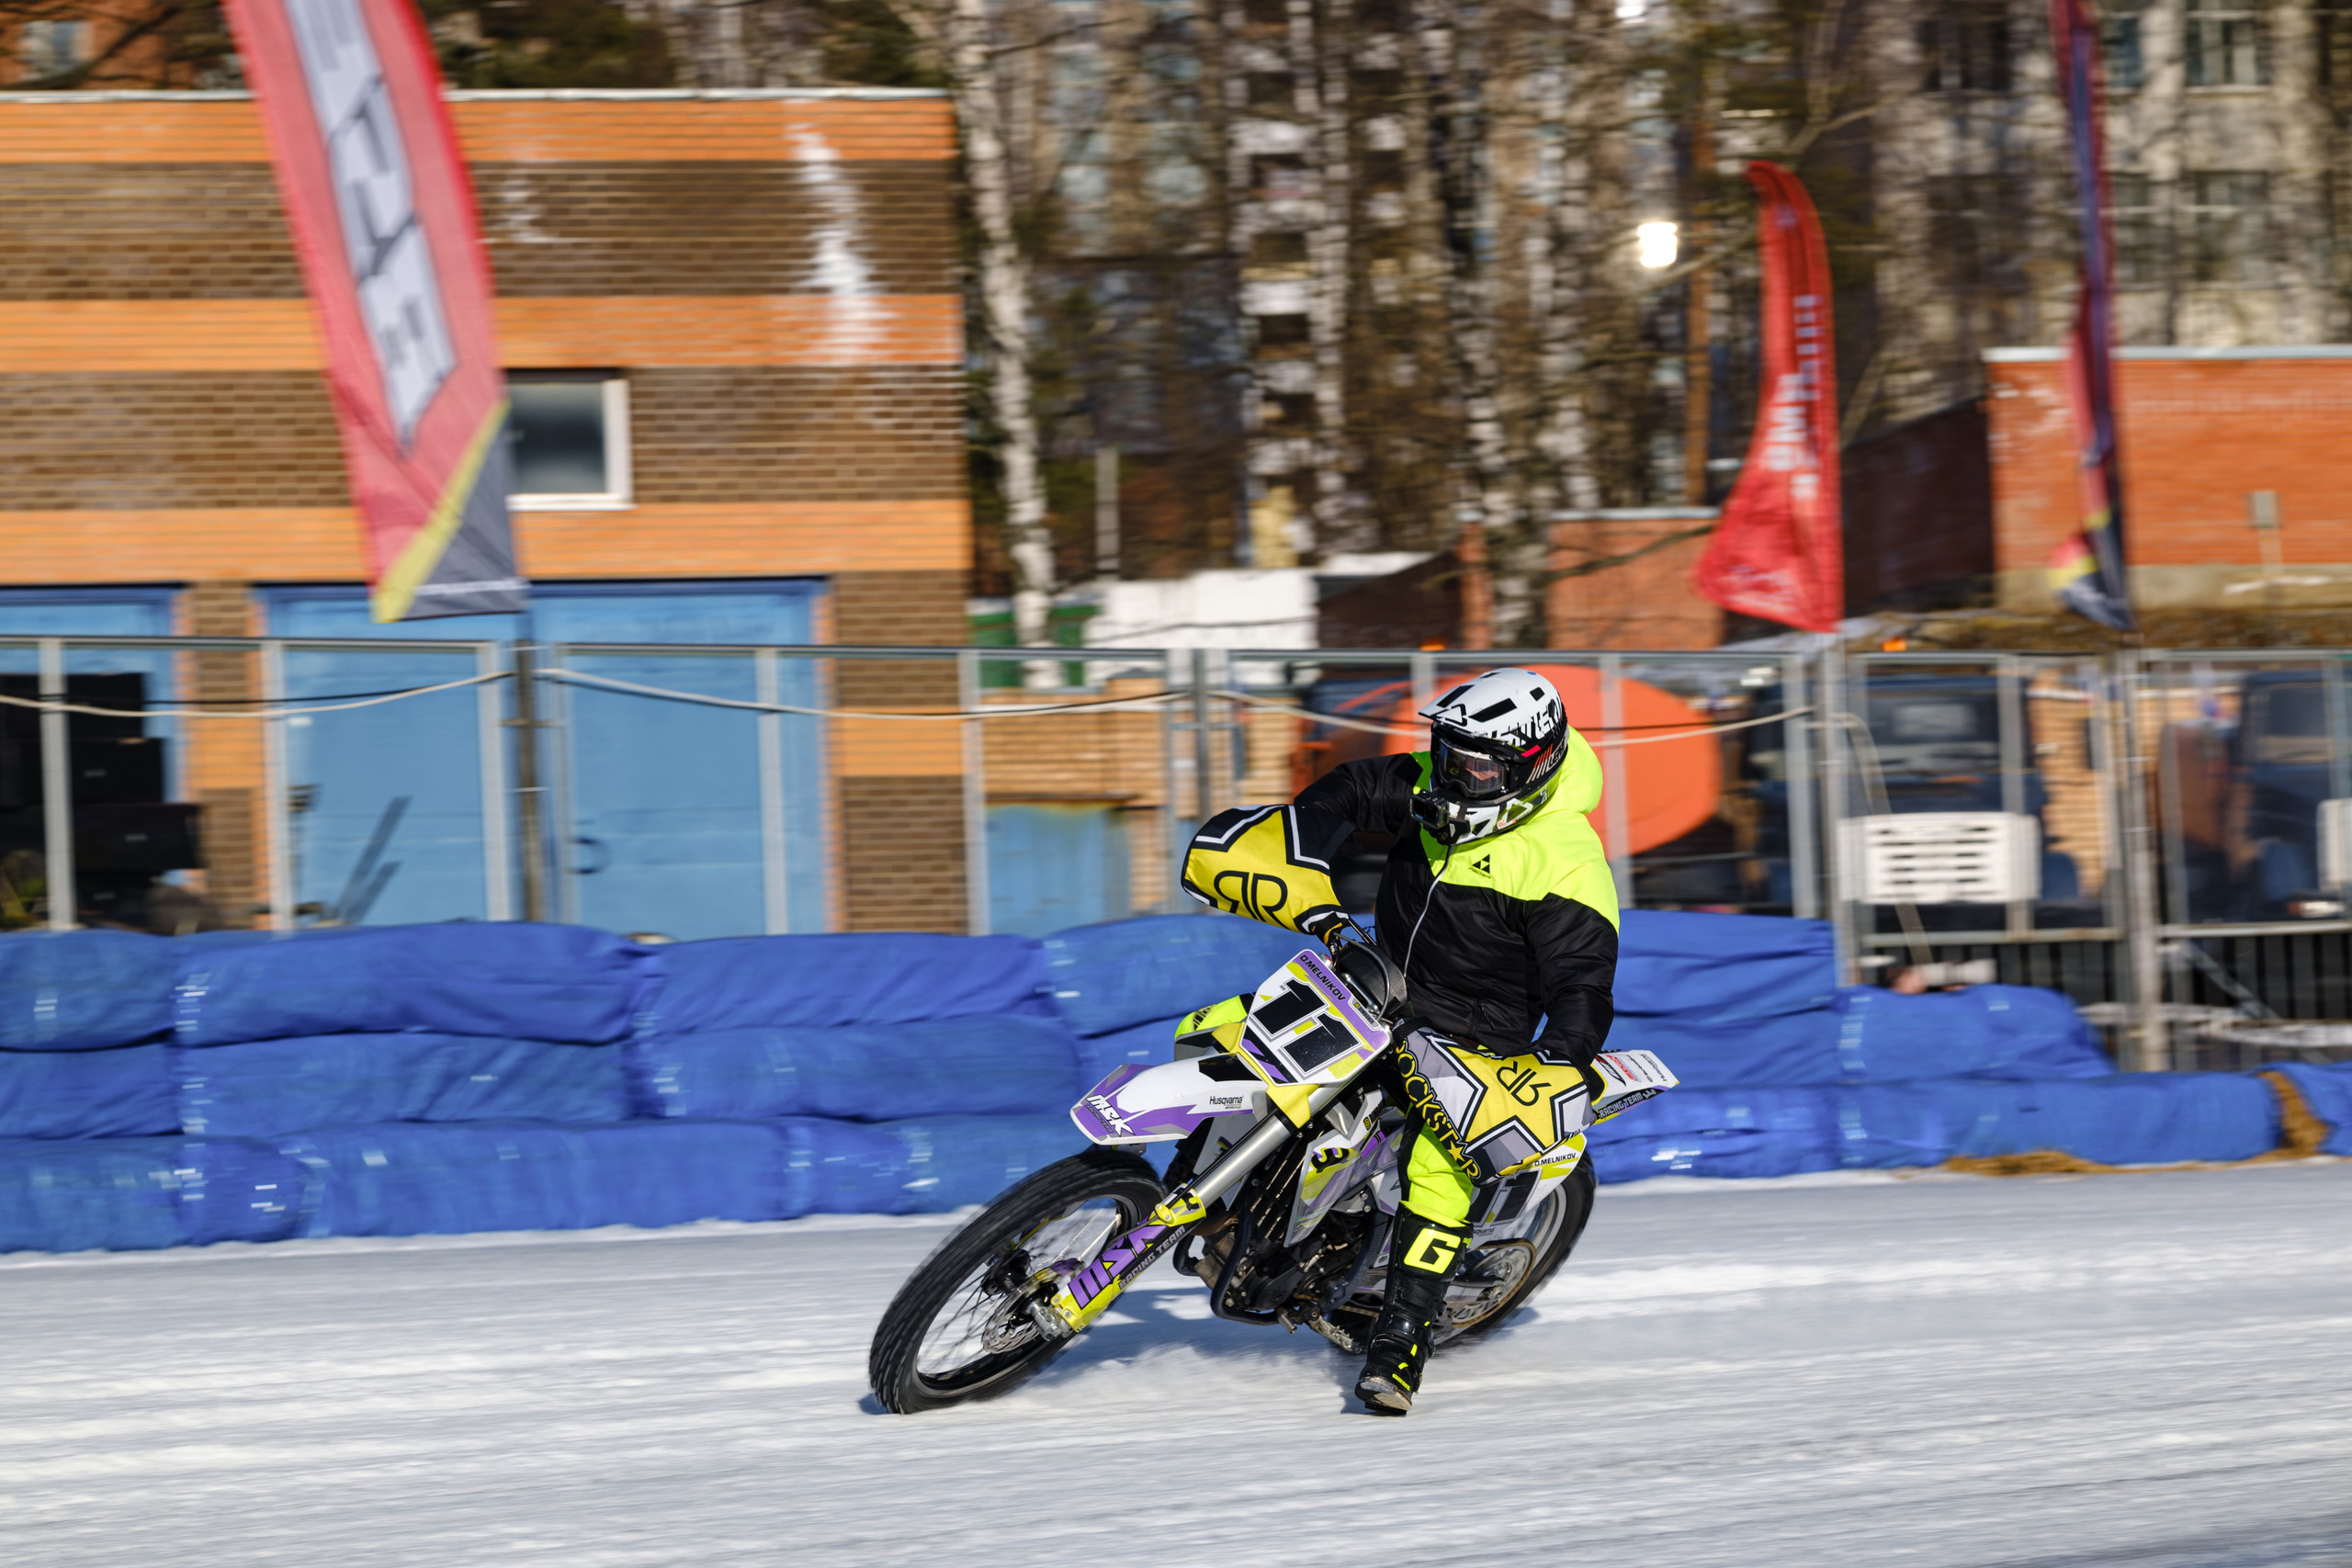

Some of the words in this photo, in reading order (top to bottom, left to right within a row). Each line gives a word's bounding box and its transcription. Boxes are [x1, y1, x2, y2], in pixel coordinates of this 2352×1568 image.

[1299, 954, 1346, 1001] D.MELNIKOV
[1251, 978, 1363, 1075] 11
[1085, 1094, 1136, 1137] MSK
[1209, 1095, 1243, 1106] Husqvarna
[1599, 1100, 1625, 1119] RACING
[1624, 1091, 1644, 1108] TEAM
[1534, 1153, 1577, 1167] D.MELNIKOV
[1069, 1215, 1168, 1310] MSK
[1118, 1252, 1156, 1290] RACING
[1155, 1224, 1186, 1254] TEAM
[1404, 1227, 1461, 1274] G
